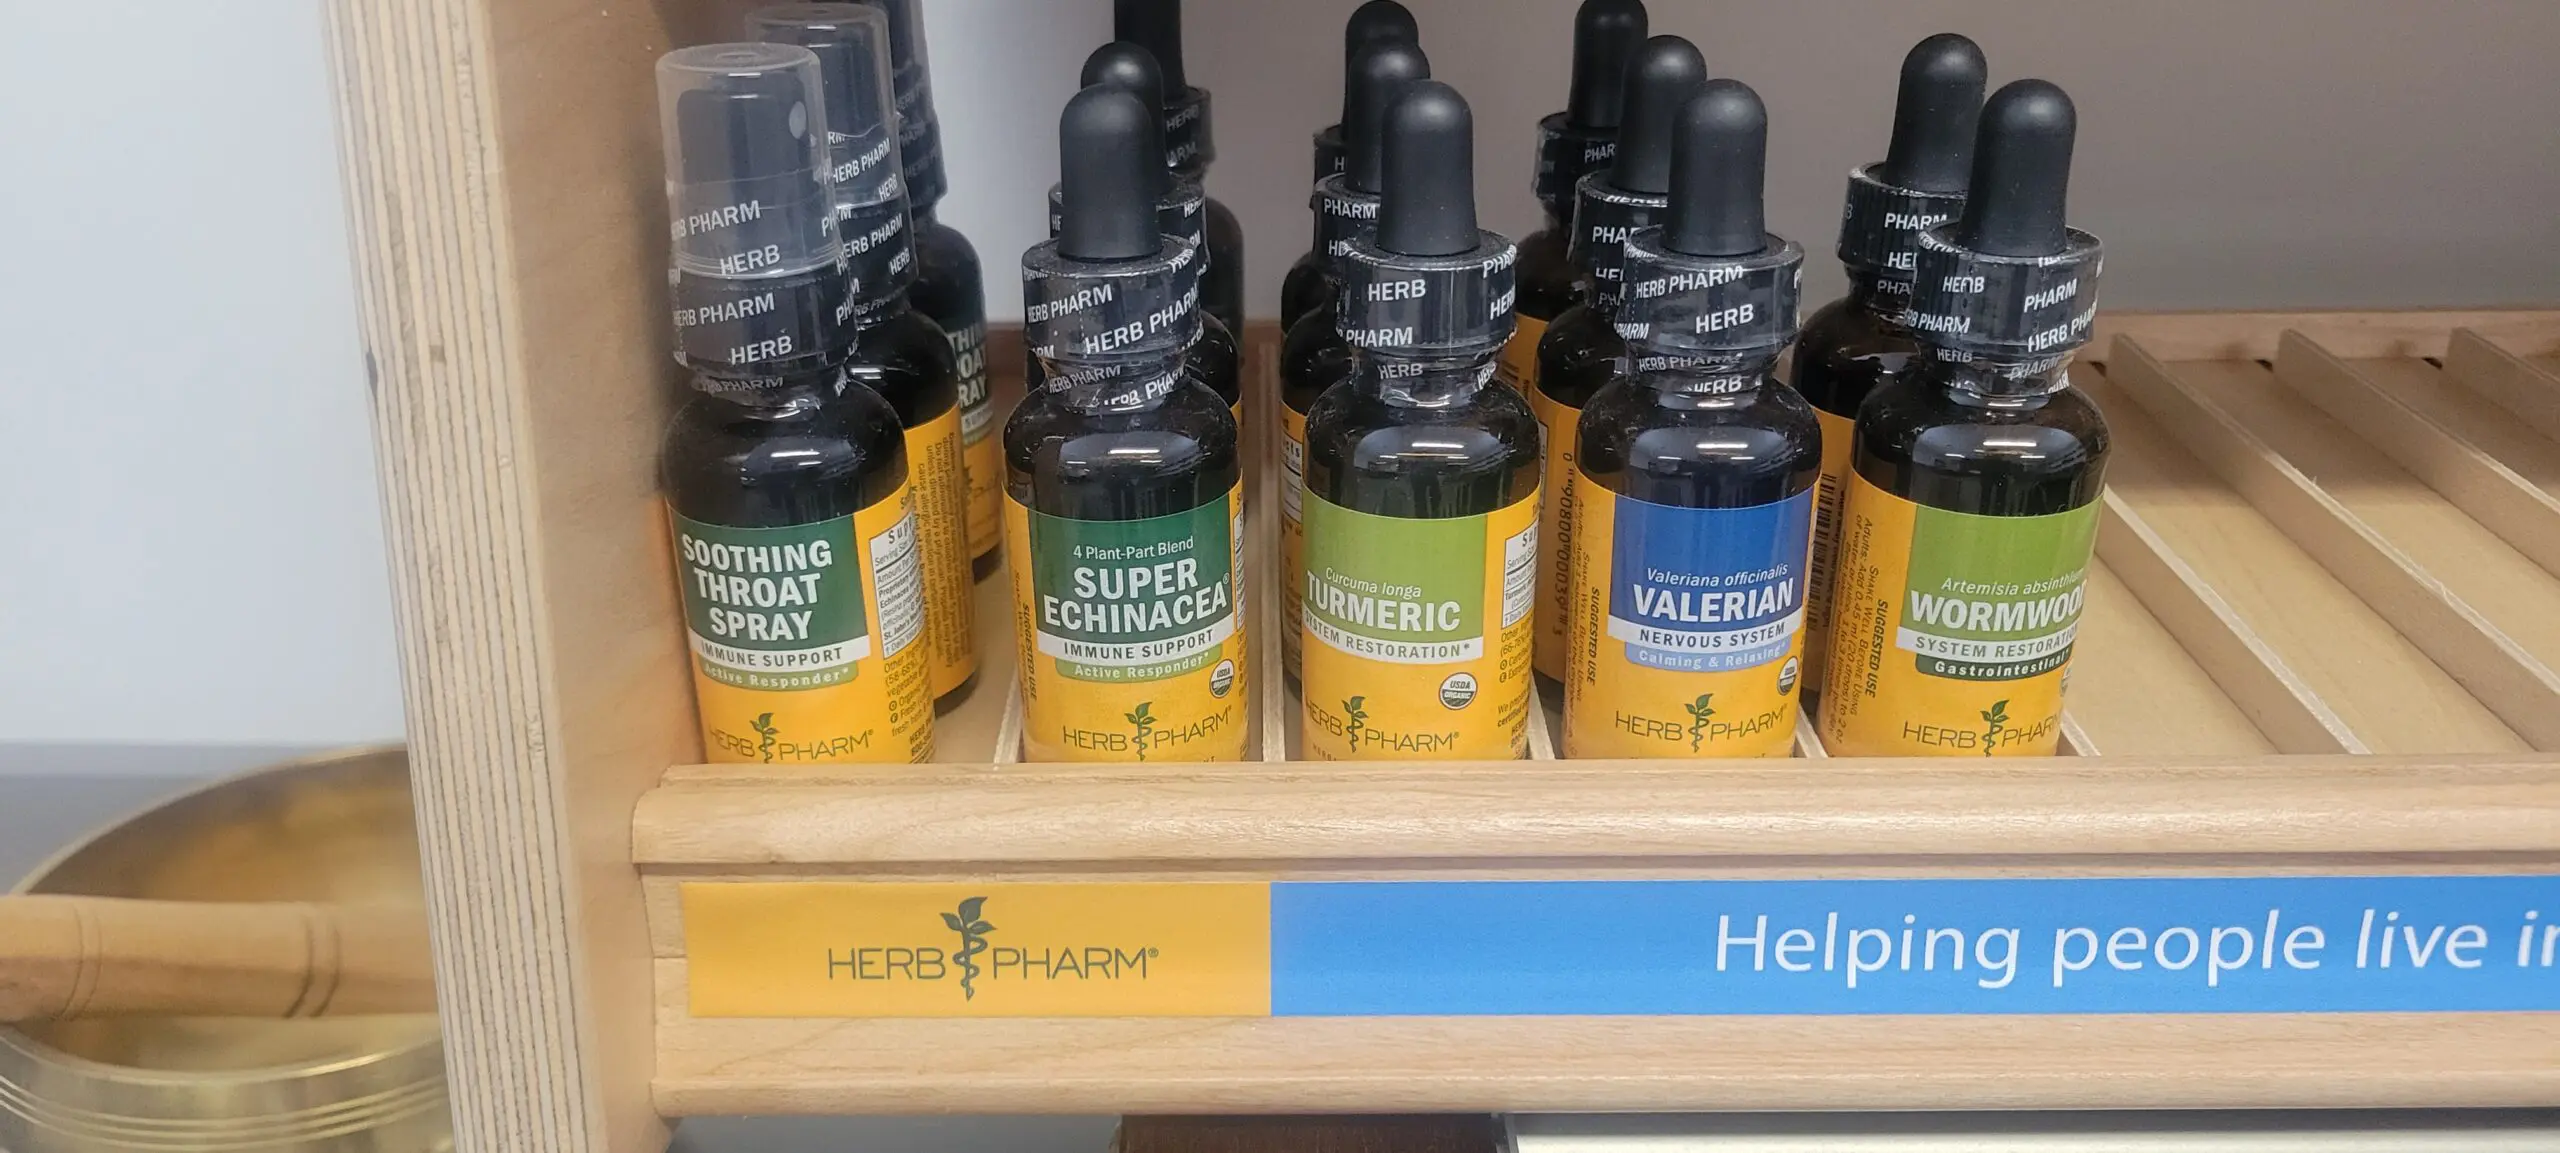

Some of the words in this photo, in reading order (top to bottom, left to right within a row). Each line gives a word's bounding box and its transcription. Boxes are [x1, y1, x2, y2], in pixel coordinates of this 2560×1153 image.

[861, 137, 890, 171] PHARM
[1585, 143, 1616, 163] PHAR
[879, 173, 897, 202] HERB
[689, 200, 761, 235] PHARM
[1324, 198, 1376, 219] PHARM
[871, 213, 903, 248] PHARM
[719, 244, 780, 275] HERB
[1368, 279, 1426, 301] HERB
[1636, 279, 1666, 298] HERB
[1669, 265, 1743, 294] PHARM
[2024, 278, 2077, 313] PHARM
[700, 293, 775, 325] PHARM
[1028, 304, 1048, 323] HERB
[1052, 284, 1112, 318] PHARM
[1085, 322, 1144, 354] HERB
[1150, 283, 1199, 333] PHARM
[1696, 303, 1754, 334] HERB
[1346, 327, 1413, 348] PHARM
[1917, 314, 1970, 333] PHARM
[2028, 325, 2068, 352] HERB
[731, 335, 792, 365] HERB
[1639, 354, 1666, 372] HERB
[1072, 366, 1121, 387] PHARM
[1377, 363, 1423, 380] HERB
[681, 533, 832, 574] SOOTHING
[1073, 545, 1082, 559] 4
[1086, 545, 1155, 561] Plant-Part
[1158, 535, 1194, 557] Blend
[1859, 517, 1873, 560] Adults:
[694, 566, 821, 608] THROAT
[1073, 557, 1199, 600] SUPER
[1325, 566, 1378, 593] Curcuma
[1382, 580, 1422, 600] longa
[1647, 566, 1720, 587] Valeriana
[1725, 562, 1789, 588] officinalis
[1856, 564, 1867, 587] Add
[1941, 576, 2019, 597] Artemisia
[1307, 570, 1462, 632] TURMERIC
[1632, 577, 1795, 623] VALERIAN
[709, 606, 813, 641] SPRAY
[1304, 609, 1341, 645] SYSTEM
[1587, 587, 1600, 658] SUGGESTED
[1640, 628, 1722, 648] NERVOUS
[1729, 623, 1785, 647] SYSTEM
[1869, 599, 1888, 671] SUGGESTED
[701, 641, 757, 668] IMMUNE
[763, 647, 843, 668] SUPPORT
[1064, 641, 1135, 660] IMMUNE
[1142, 629, 1214, 658] SUPPORT
[1916, 636, 1986, 658] SYSTEM
[703, 664, 745, 685] Active
[1074, 663, 1121, 679] Active
[1587, 659, 1597, 686] USE
[1639, 650, 1702, 671] Calming
[1708, 655, 1718, 667] &
[1450, 680, 1471, 690] USDA
[1865, 672, 1878, 699] USE
[1305, 698, 1343, 737] HERB
[1615, 711, 1682, 742] HERB
[709, 727, 756, 758] HERB
[1063, 725, 1128, 752] HERB
[1903, 720, 1977, 749] HERB
[828, 947, 946, 980] HERB
[1716, 911, 2021, 990] Helping
[2051, 909, 2326, 988] people
[2356, 908, 2488, 970] live
